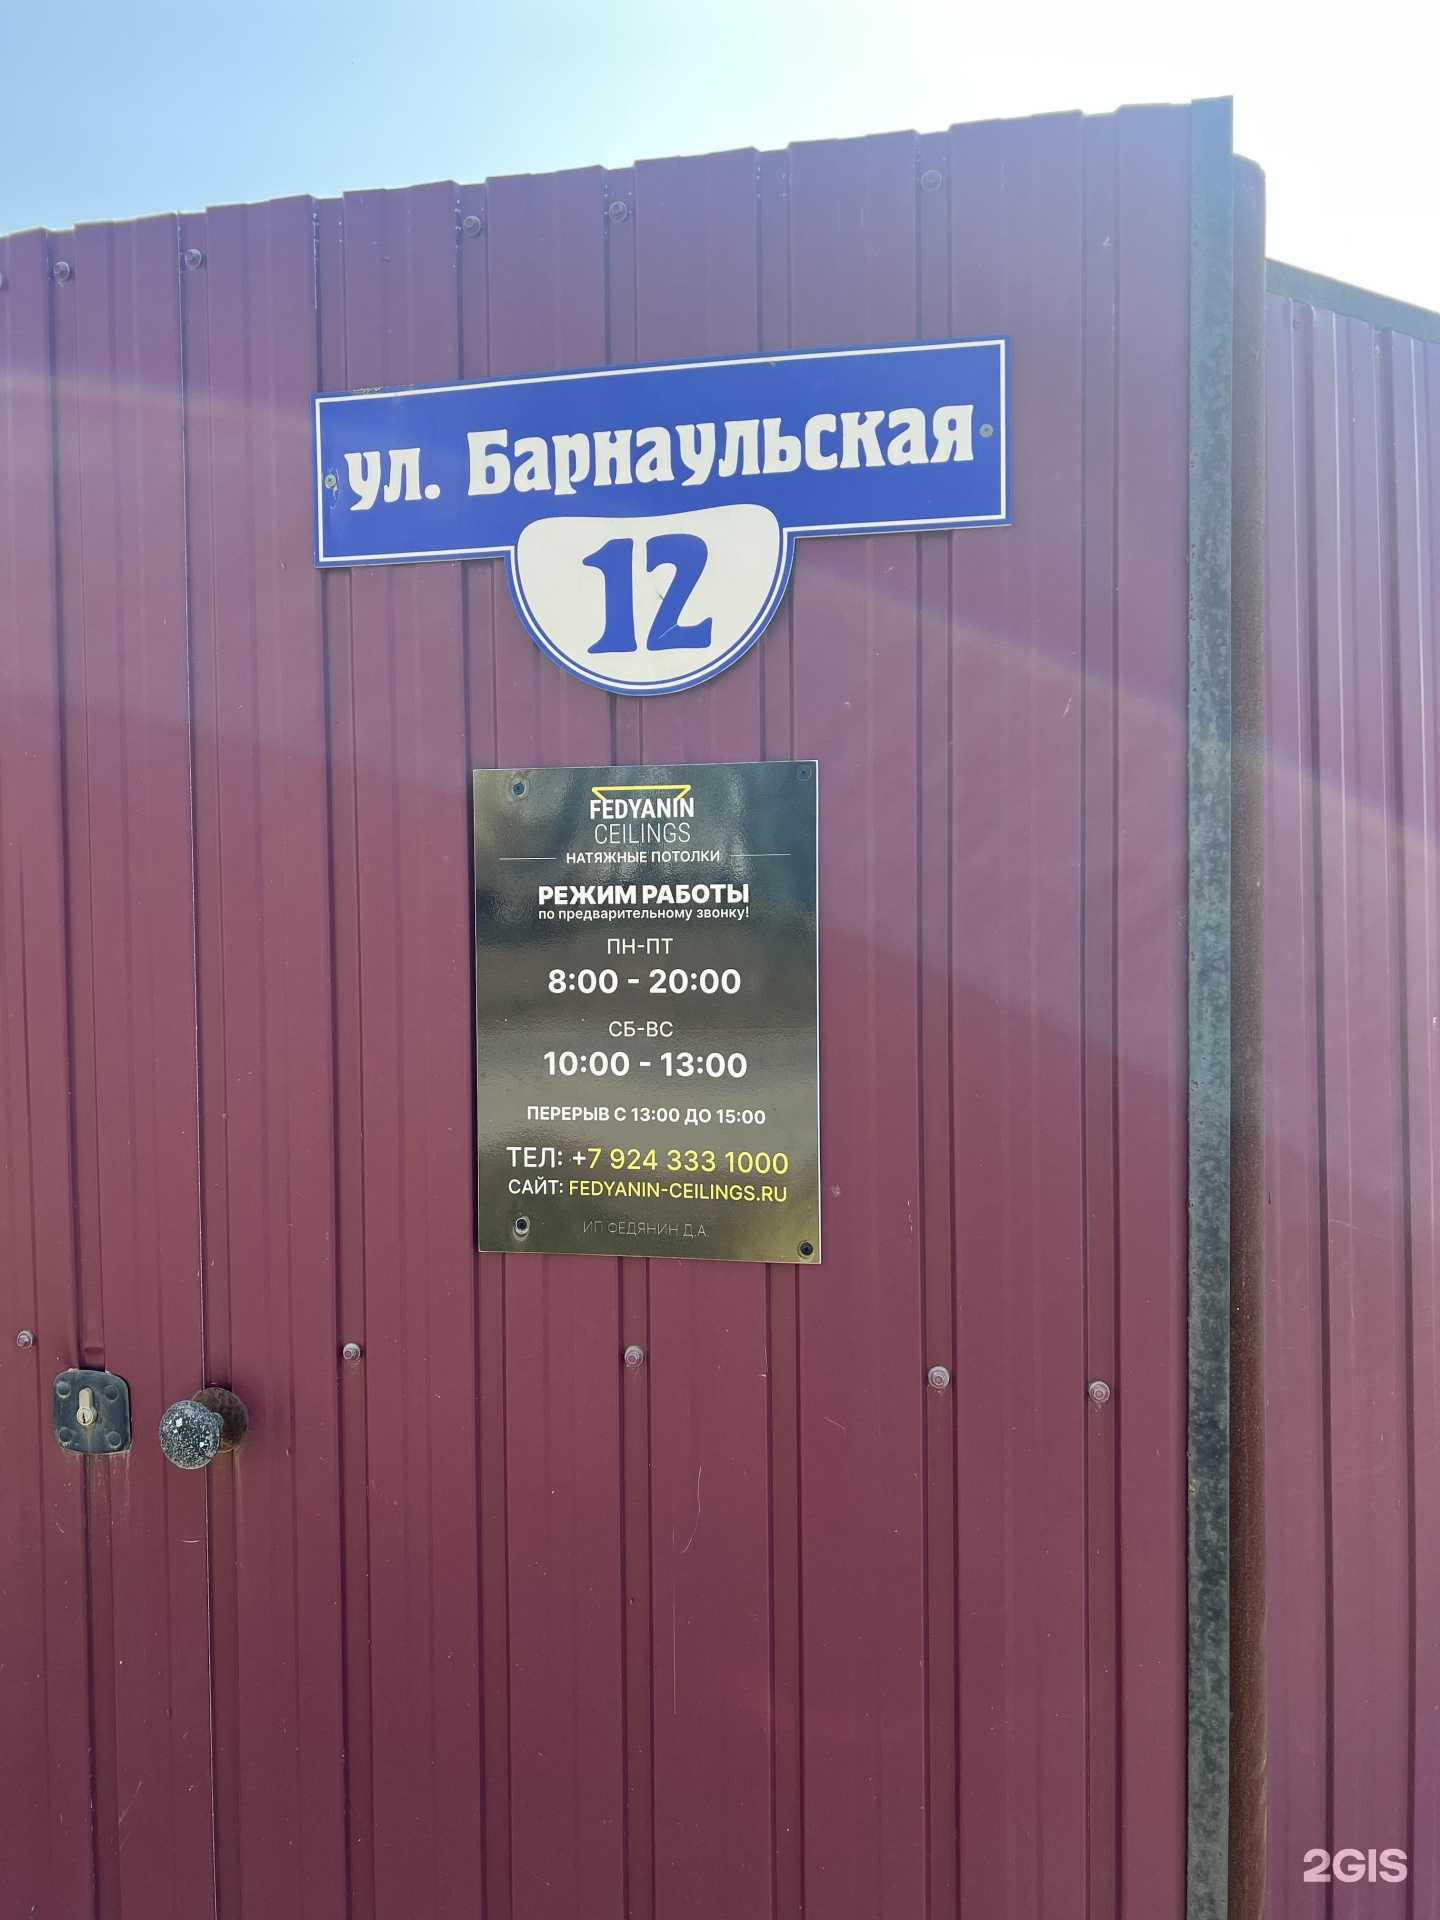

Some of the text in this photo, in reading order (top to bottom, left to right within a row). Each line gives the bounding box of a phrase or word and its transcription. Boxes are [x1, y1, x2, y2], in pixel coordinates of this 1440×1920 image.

[344, 405, 975, 511] ул. Барнаульская
[582, 533, 713, 654] 12
[589, 797, 695, 820] FEDYANIN
[594, 822, 691, 845] CEILINGS
[566, 850, 720, 864] НАТЯЖНЫЕ ПОТОЛКИ
[538, 883, 749, 905] РЕЖИМ РАБОТЫ
[538, 906, 750, 921] по предварительному звонку!
[607, 938, 674, 955] ПН-ПТ
[548, 969, 618, 994] 8:00
[649, 968, 741, 994] 20:00
[608, 1021, 674, 1038] СБ-ВС
[544, 1051, 630, 1077] 10:00
[660, 1052, 748, 1078] 13:00
[527, 1106, 766, 1126] ПЕРЕРЫВ С 13:00 ДО 15:00
[506, 1147, 789, 1174] ТЕЛ: +7 924 333 1000
[508, 1176, 788, 1202] САЙТ: FEDYANIN-CEILINGS.RU
